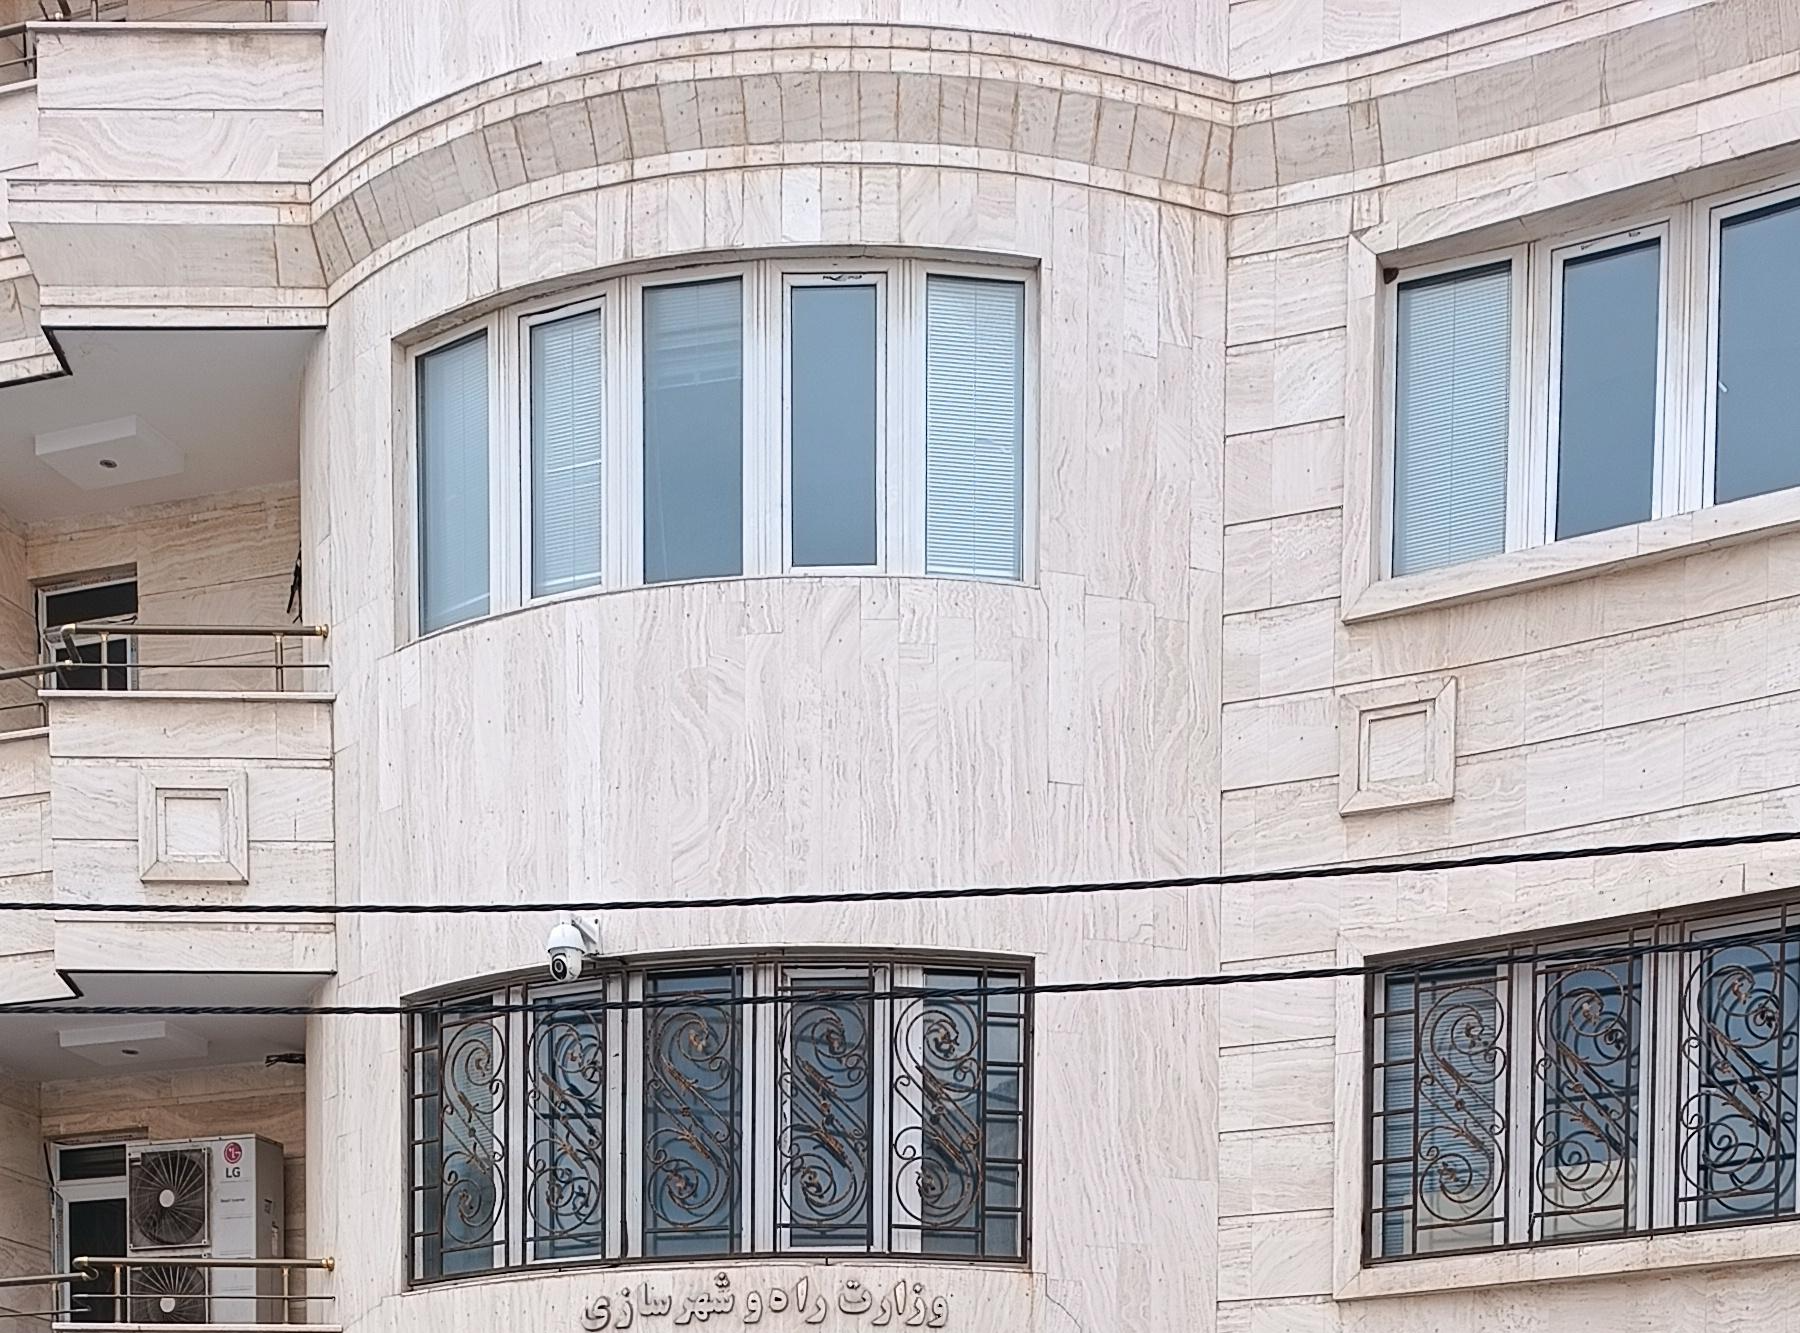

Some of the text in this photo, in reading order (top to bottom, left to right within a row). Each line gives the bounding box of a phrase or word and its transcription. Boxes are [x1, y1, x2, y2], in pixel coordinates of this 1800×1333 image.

[225, 1166, 241, 1178] LG
[743, 1289, 764, 1324] و
[769, 1275, 828, 1324] راه
[838, 1279, 949, 1328] وزارت
